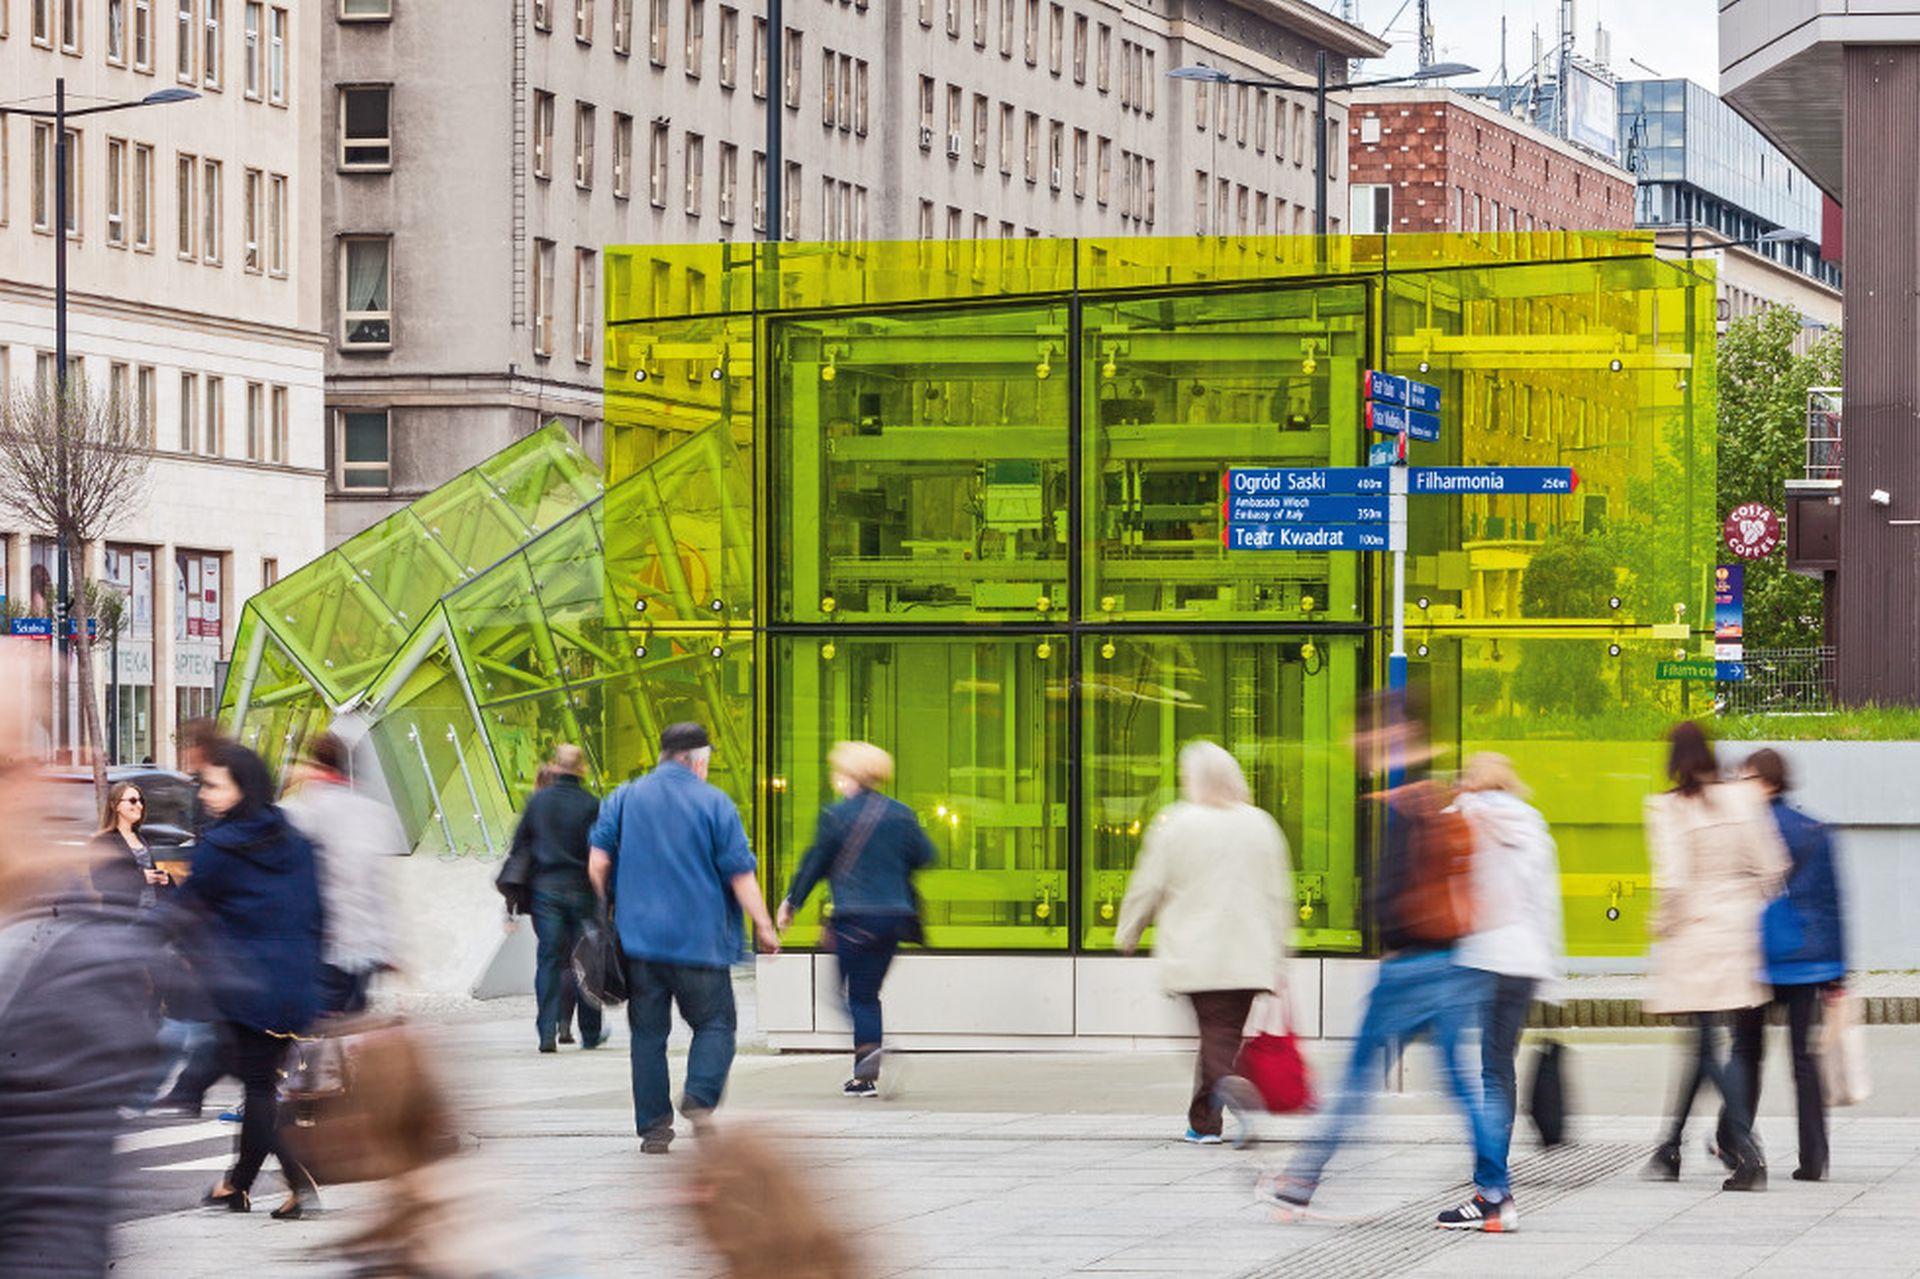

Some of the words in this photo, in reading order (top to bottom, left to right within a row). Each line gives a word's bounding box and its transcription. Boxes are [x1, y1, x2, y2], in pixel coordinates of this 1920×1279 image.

[1235, 472, 1281, 494] Ogród
[1288, 472, 1326, 490] Saski
[1357, 479, 1382, 489] 400m
[1416, 471, 1504, 489] Filharmonia
[1234, 509, 1271, 521] Embassy
[1273, 509, 1282, 519] of
[1285, 509, 1304, 521] Italy
[1731, 504, 1770, 522] COSTA
[1235, 528, 1274, 545] Teatr
[1280, 527, 1344, 545] Kwadrat
[1359, 535, 1384, 545] 100m
[1729, 536, 1776, 557] COFFEE
